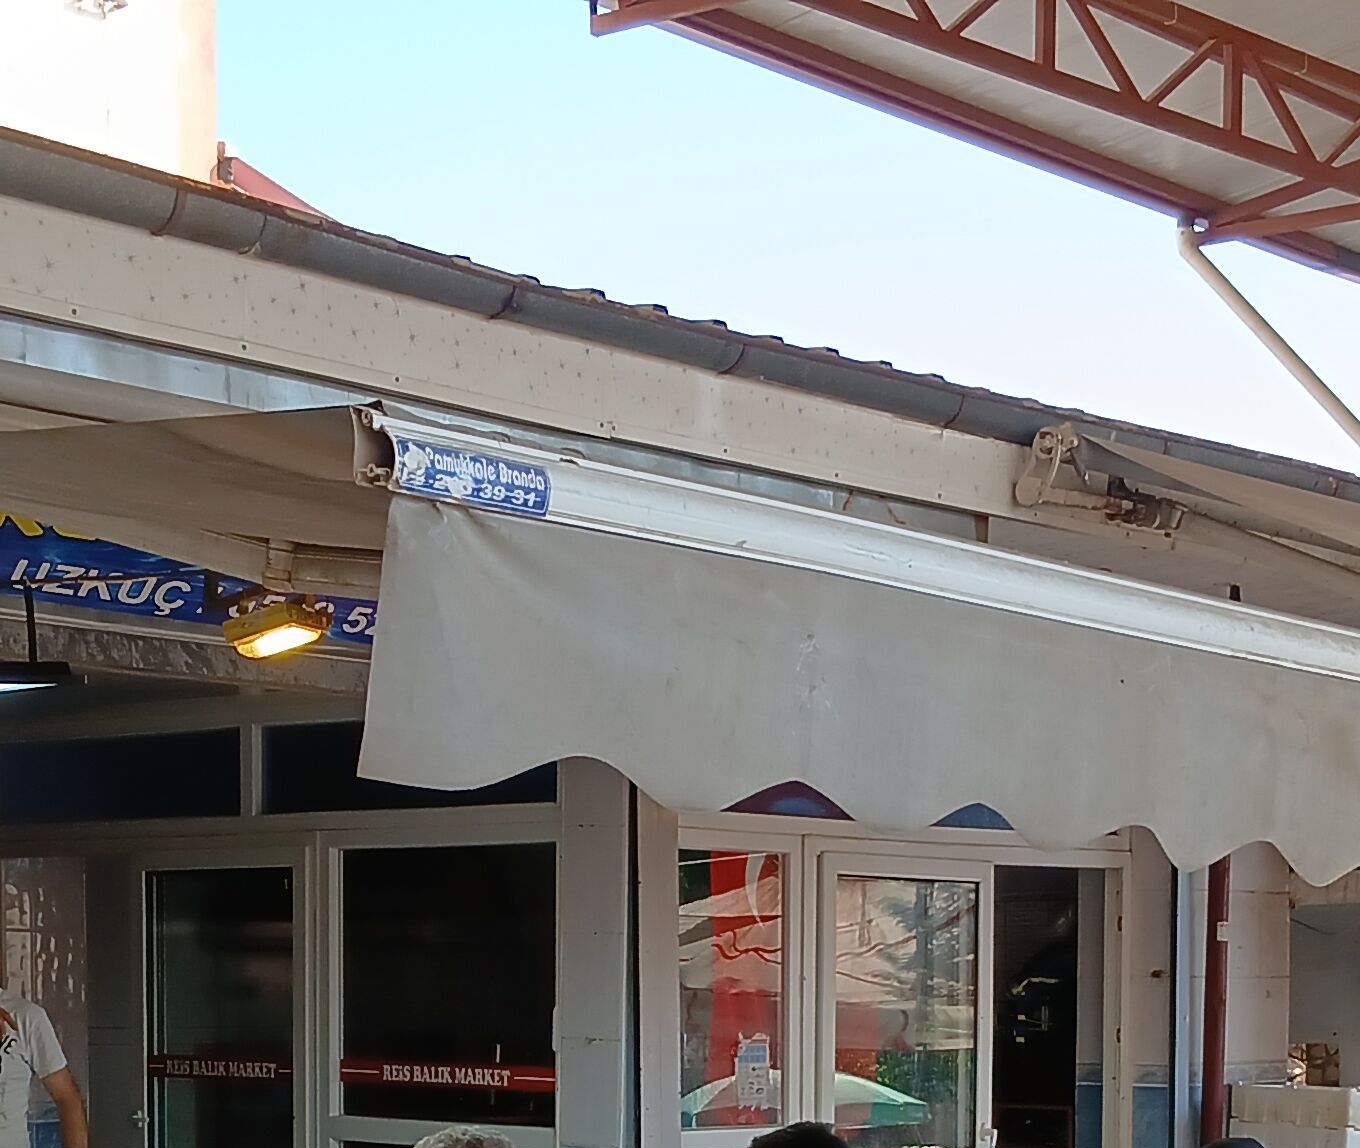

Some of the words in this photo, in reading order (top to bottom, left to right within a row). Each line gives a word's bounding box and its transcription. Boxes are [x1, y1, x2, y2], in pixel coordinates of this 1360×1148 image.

[499, 463, 545, 490] Branda
[192, 1061, 226, 1076] BALIK
[229, 1061, 277, 1079] MARKET
[413, 1066, 452, 1083] BALIK
[455, 1067, 511, 1086] MARKET
